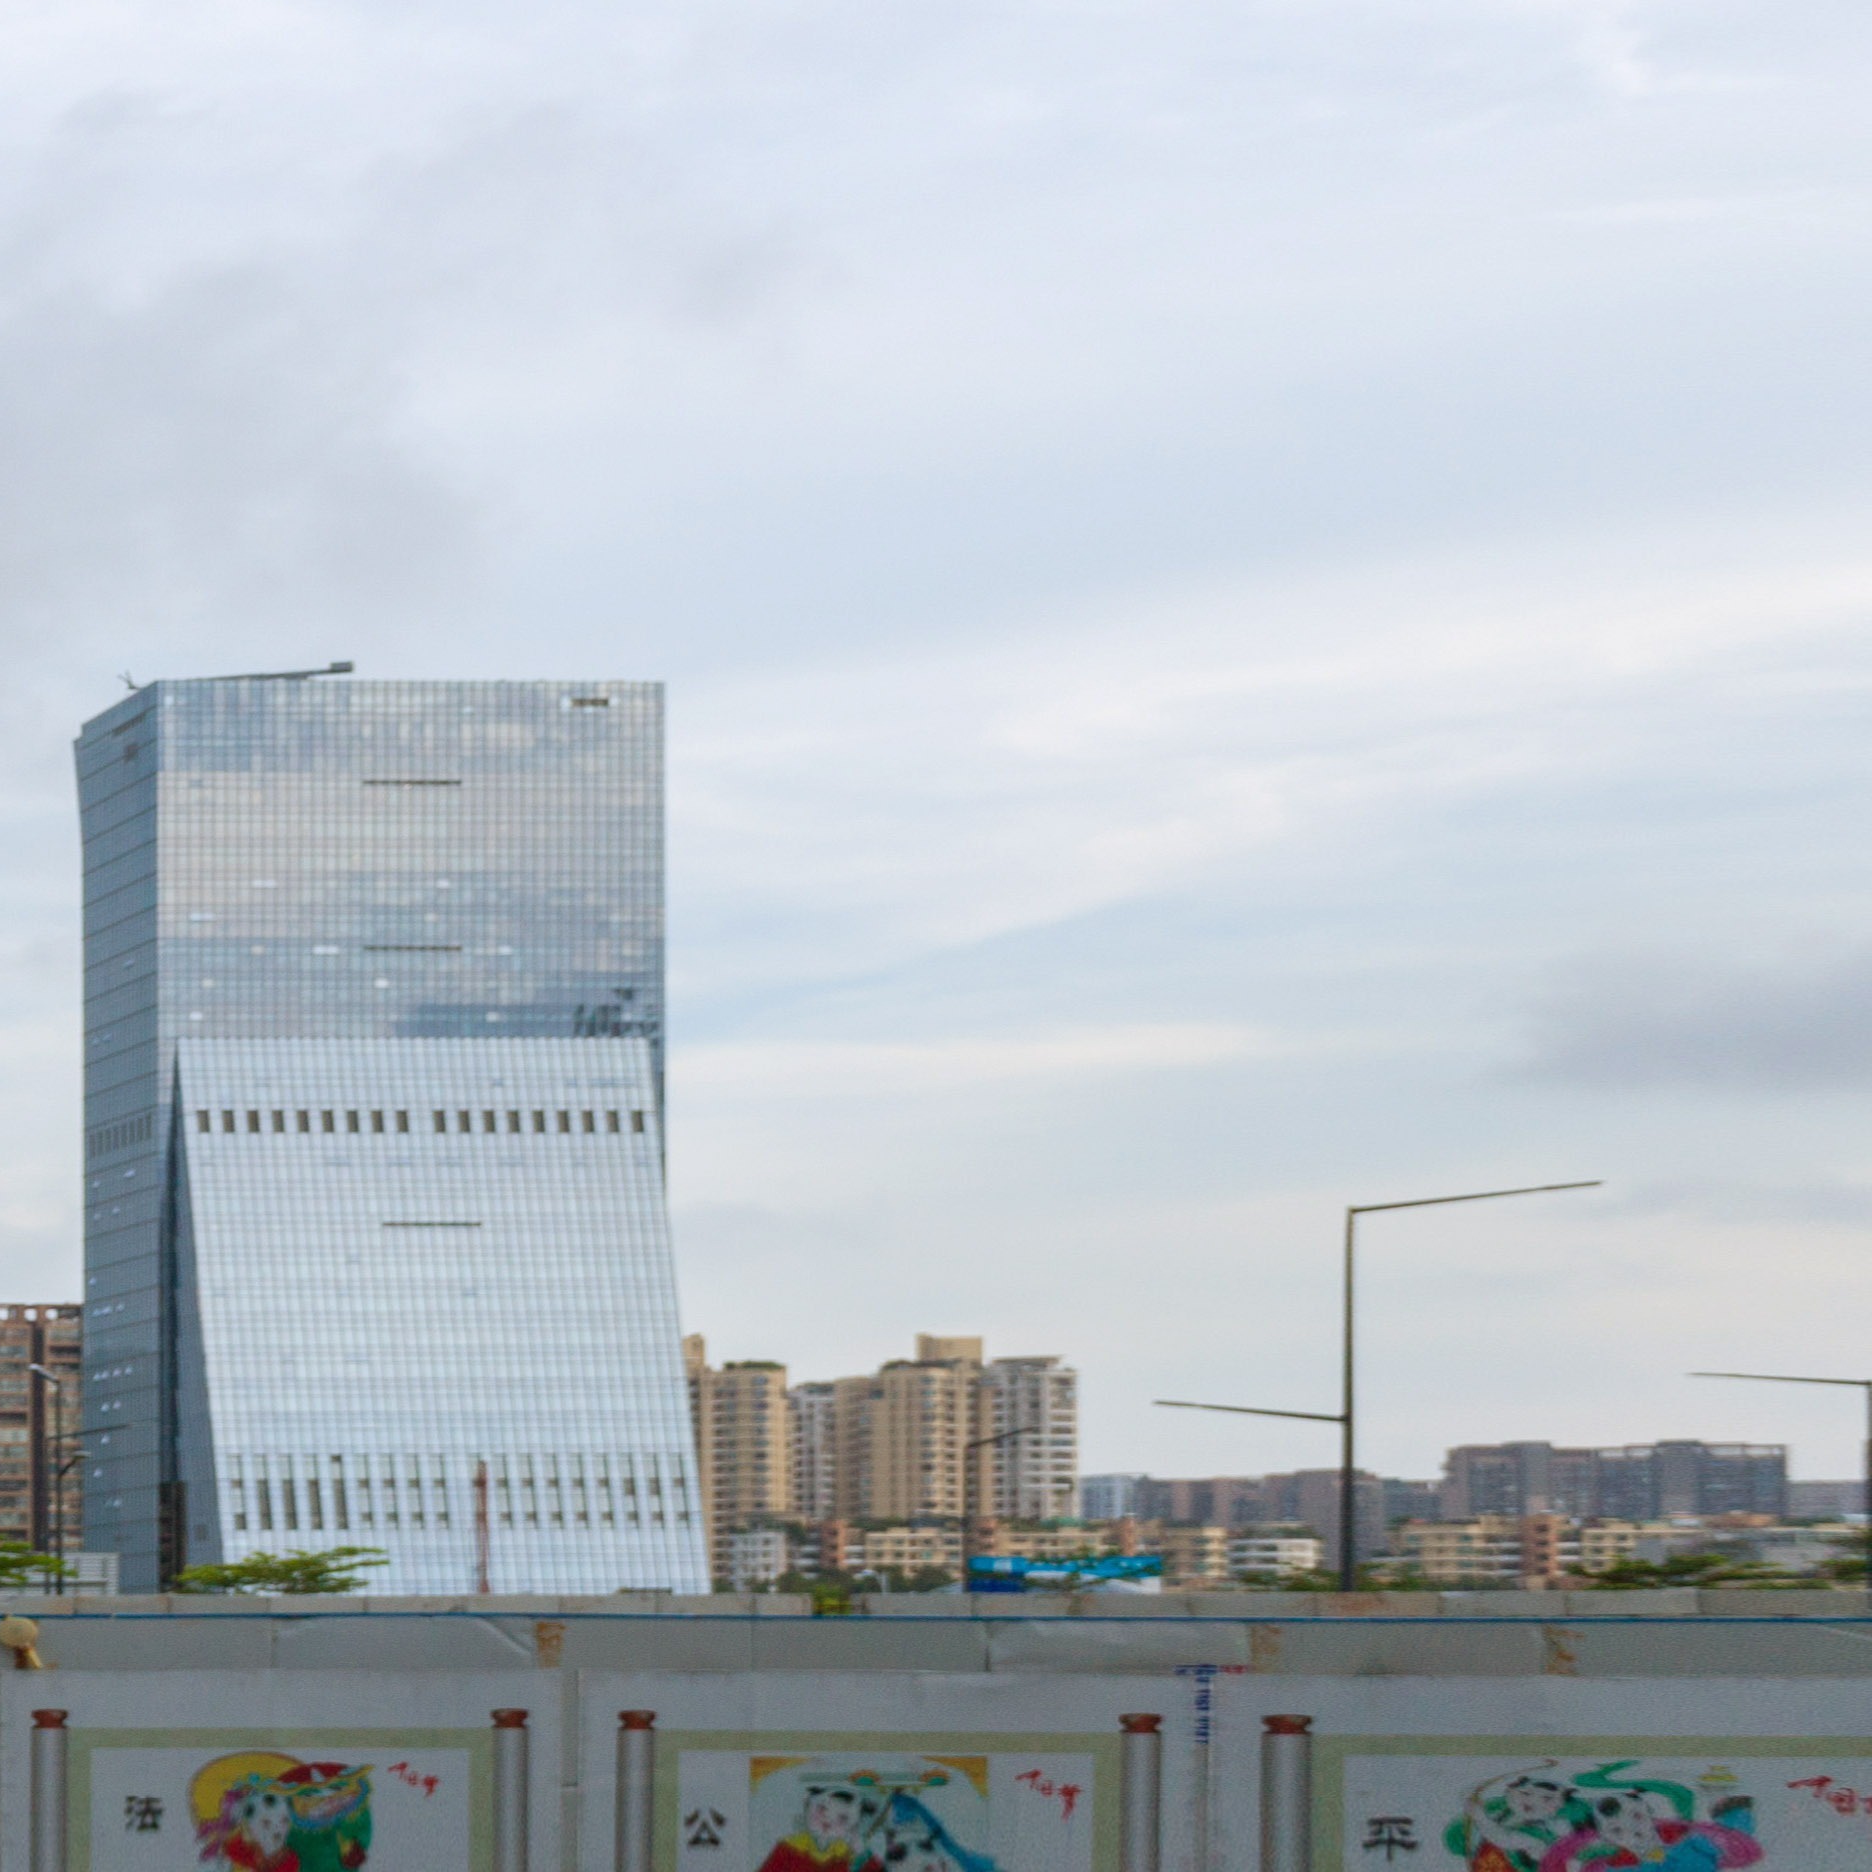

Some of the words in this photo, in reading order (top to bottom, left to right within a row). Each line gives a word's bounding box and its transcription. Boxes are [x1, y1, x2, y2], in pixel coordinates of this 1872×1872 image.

[124, 1795, 165, 1832] 法
[684, 1806, 726, 1847] 公
[1362, 1815, 1419, 1862] 平
